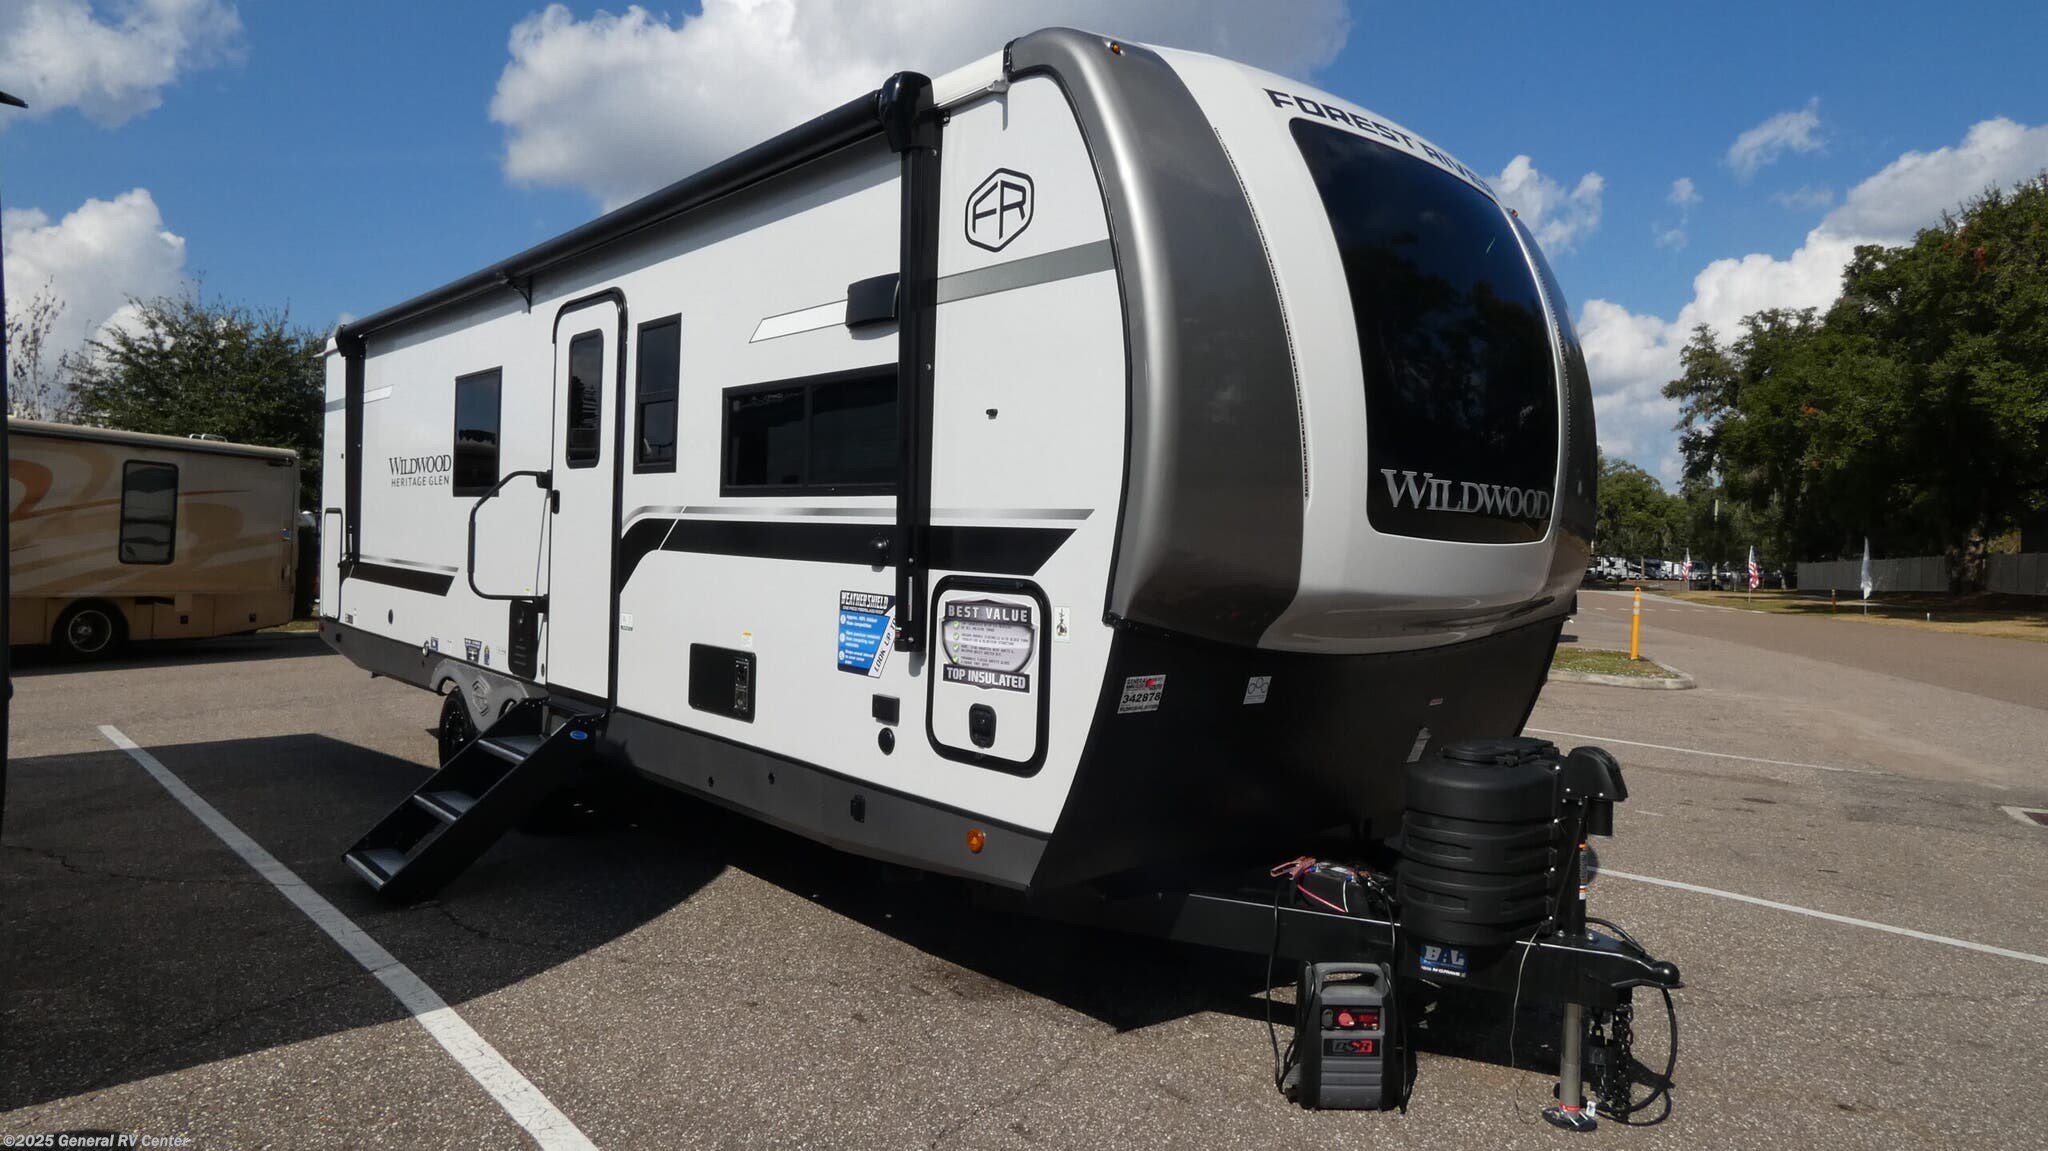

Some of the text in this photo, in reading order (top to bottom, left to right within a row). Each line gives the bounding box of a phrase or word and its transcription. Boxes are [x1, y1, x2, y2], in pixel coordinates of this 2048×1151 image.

[1262, 87, 1415, 149] FOREST
[389, 454, 452, 475] WILDWOOD
[391, 475, 450, 488] HERITAGE GLEN
[1380, 468, 1550, 519] WILDWOOD
[948, 605, 1028, 622] BEST VALUE
[946, 667, 1026, 689] TOP INSULATED
[1122, 692, 1161, 704] 342878
